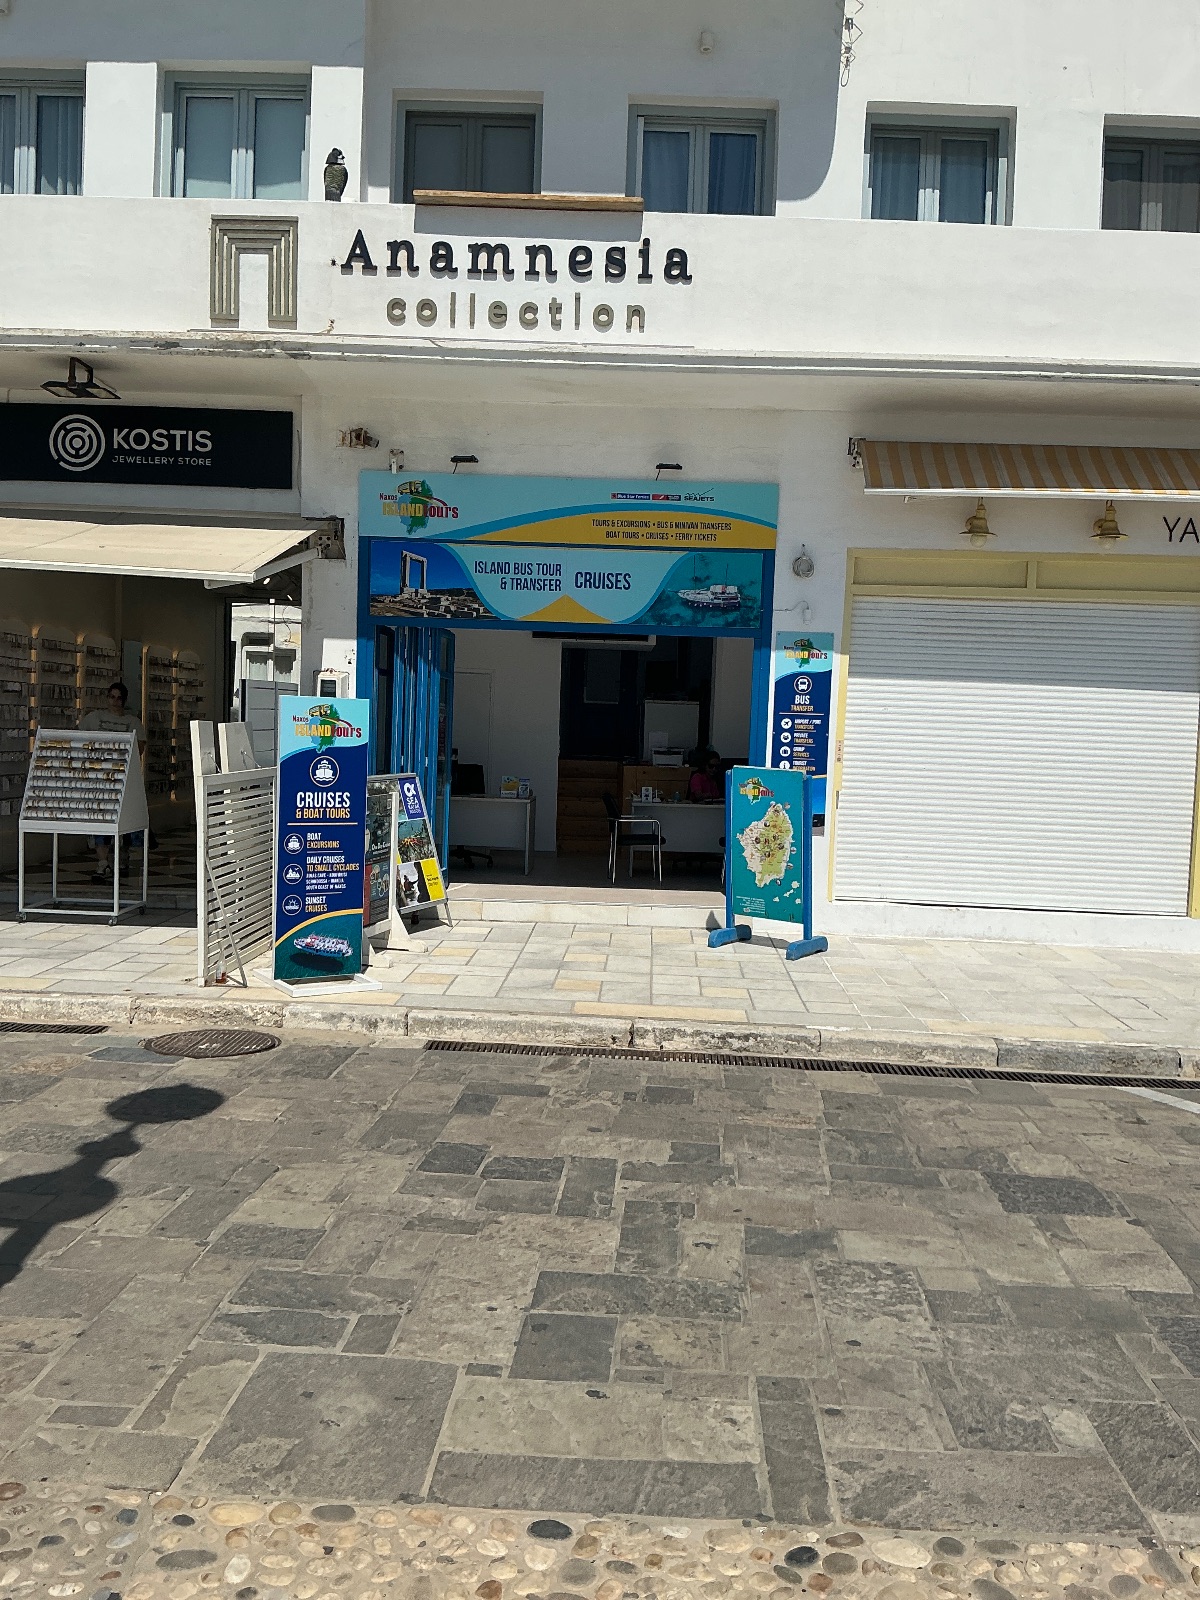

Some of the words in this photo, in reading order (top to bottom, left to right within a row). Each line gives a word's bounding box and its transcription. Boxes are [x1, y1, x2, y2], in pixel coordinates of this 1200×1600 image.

[341, 229, 692, 283] Anamnesia
[387, 292, 646, 333] collection
[113, 428, 212, 452] KOSTIS
[112, 455, 175, 465] JEWELLERY
[178, 457, 212, 466] STORE
[379, 493, 398, 501] Naxos
[592, 519, 610, 527] TOURS
[617, 520, 651, 529] EXCURSIONS
[657, 521, 668, 529] BUS
[675, 521, 699, 531] MINIVAN
[700, 522, 732, 532] TRANSFERS
[606, 531, 620, 539] BOAT
[622, 531, 640, 540] TOURS
[646, 532, 669, 541] CRUISES
[675, 532, 693, 541] FERRY
[694, 533, 717, 542] TICKETS
[474, 560, 511, 575] ISLAND
[513, 562, 533, 576] BUS
[536, 563, 562, 577] TOUR
[500, 577, 507, 590] &
[510, 578, 562, 592] TRANSFER
[574, 571, 632, 591] CRUISES
[795, 694, 810, 705] BUS
[791, 704, 813, 712] TRANSFER
[292, 715, 309, 723] Naxos
[296, 791, 351, 808] CRUISES
[295, 808, 301, 819] &
[303, 808, 324, 819] BOAT
[326, 808, 350, 819] TOURS
[306, 832, 322, 841] BOAT
[306, 841, 340, 849] EXCURSIONS
[306, 856, 322, 864] DAILY
[323, 855, 345, 864] CRUISES
[306, 864, 313, 872] TO
[314, 864, 332, 872] SMALL
[333, 863, 360, 872] CYCLADES
[305, 896, 326, 905] SUNSET
[305, 905, 328, 913] CRUISES
